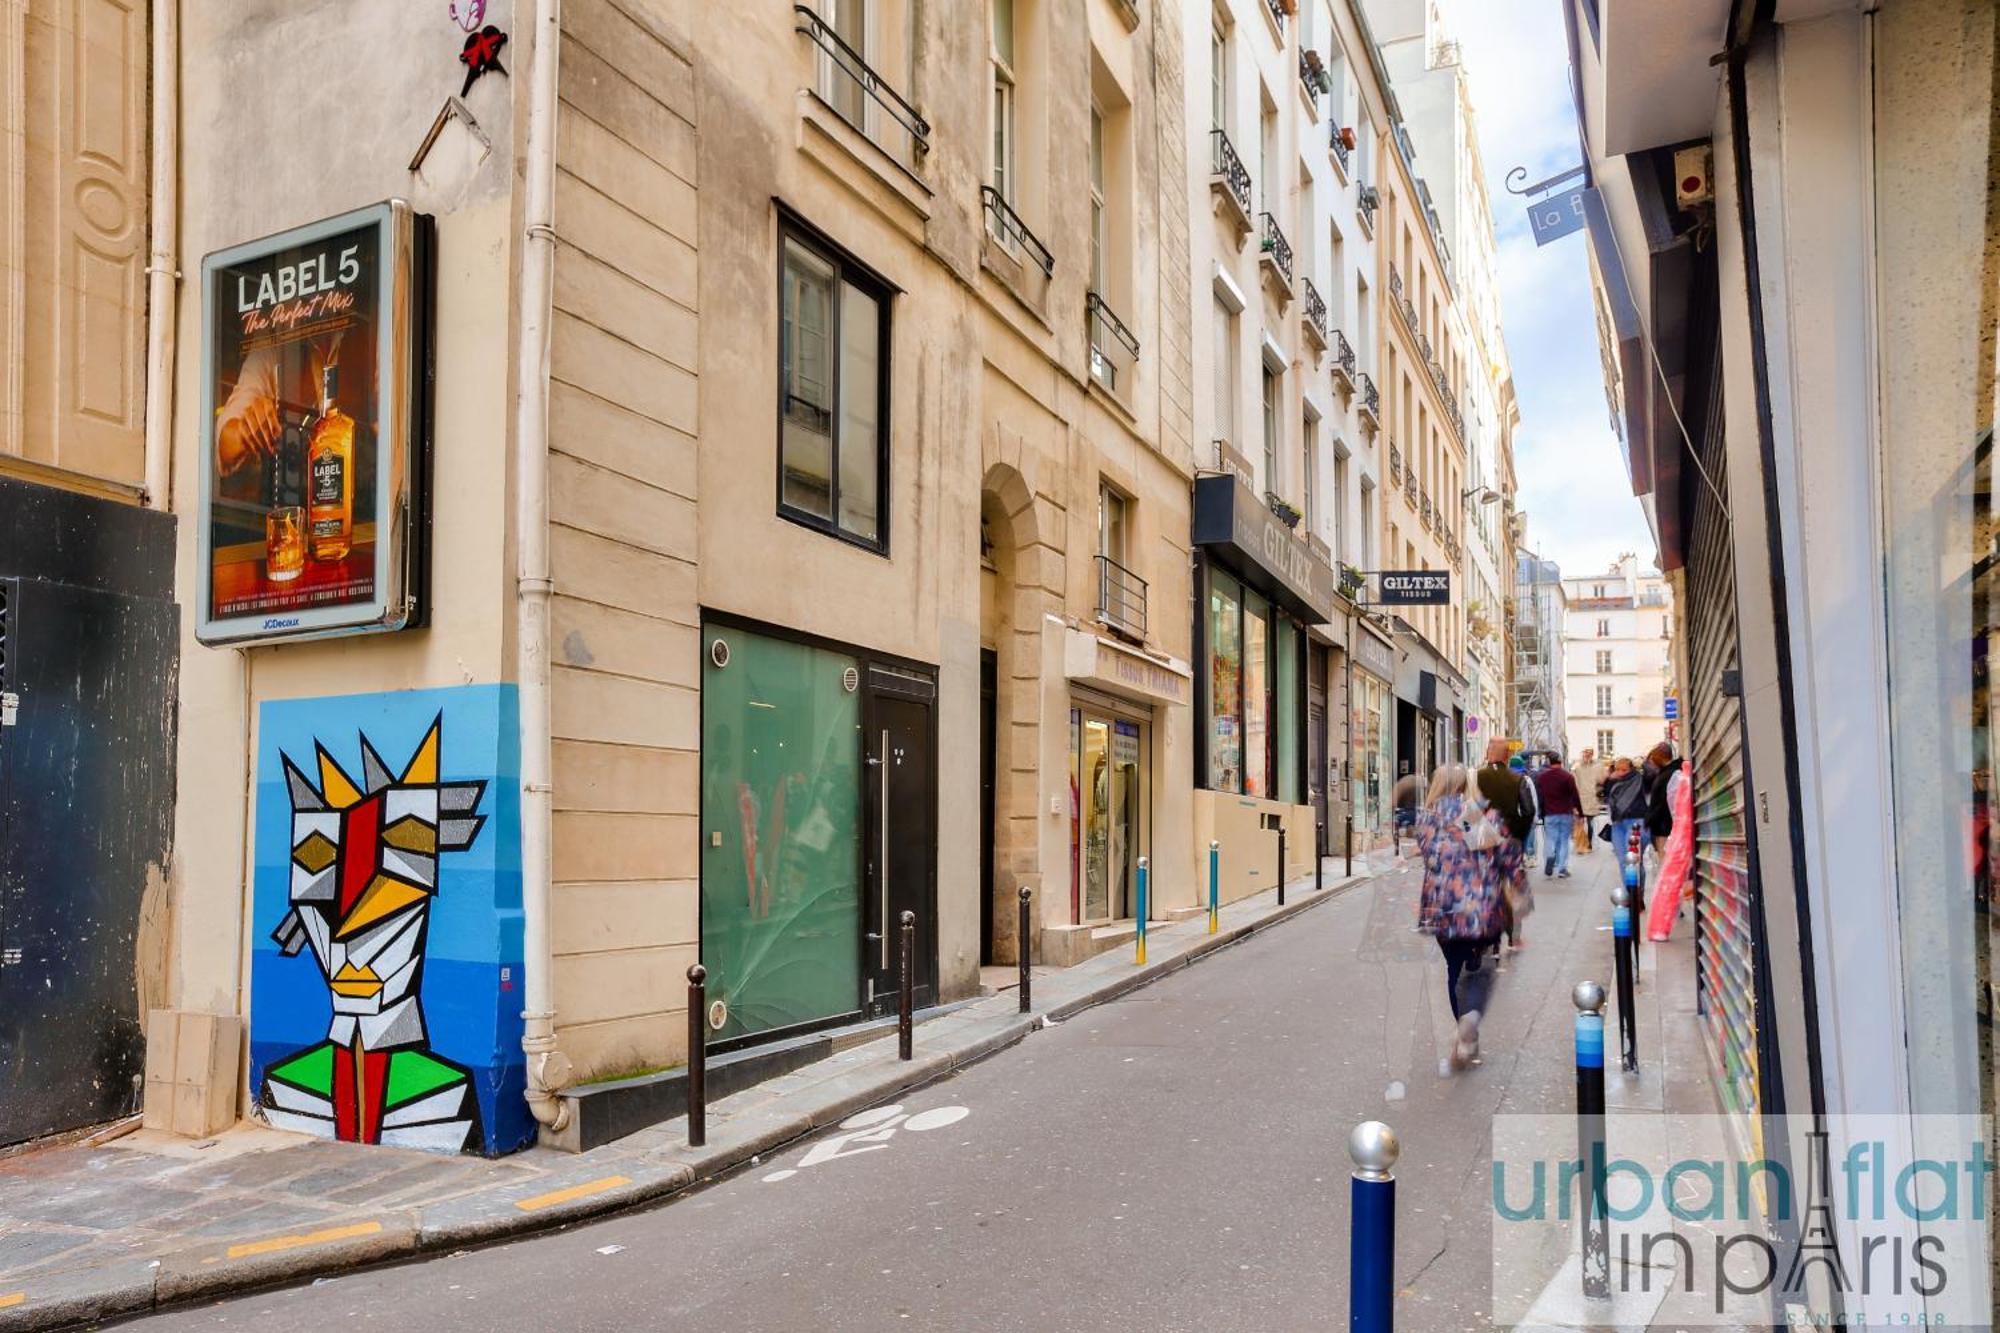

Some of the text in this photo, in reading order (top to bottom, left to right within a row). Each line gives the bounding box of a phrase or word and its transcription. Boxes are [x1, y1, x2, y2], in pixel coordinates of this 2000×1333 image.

[238, 244, 360, 313] LABEL 5
[241, 309, 269, 335] The
[270, 294, 324, 329] Perfect
[314, 463, 342, 477] LABEL
[323, 475, 332, 487] 5
[1264, 521, 1313, 596] GILTEX
[1383, 576, 1449, 590] GILTEX
[263, 618, 300, 630] JCDecaux
